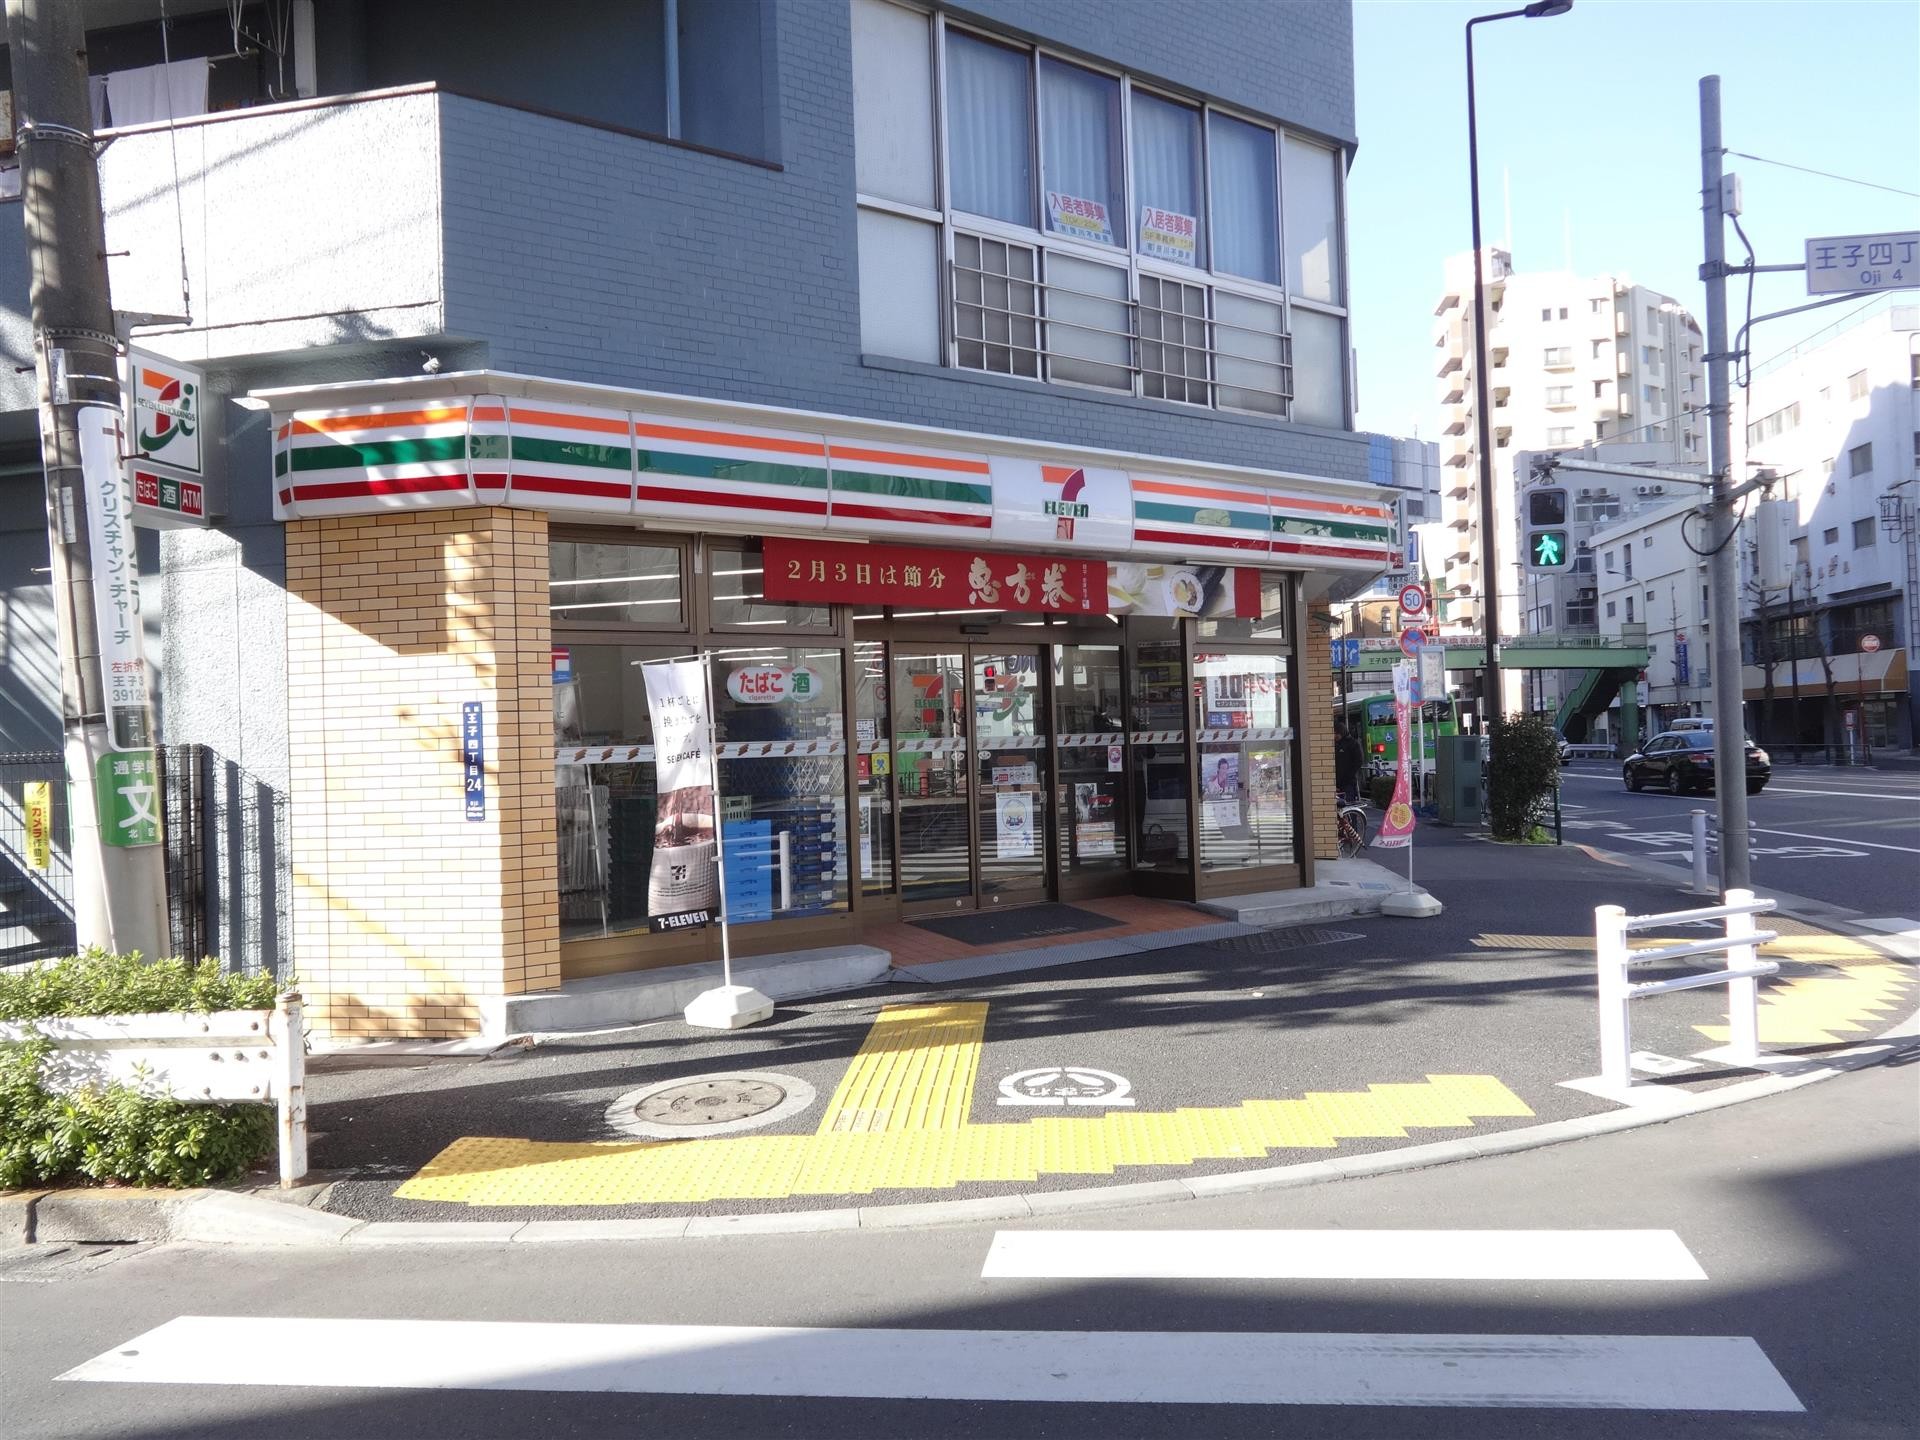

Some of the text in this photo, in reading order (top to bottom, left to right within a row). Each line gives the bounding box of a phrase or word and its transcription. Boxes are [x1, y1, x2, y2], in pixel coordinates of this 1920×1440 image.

[1051, 193, 1105, 221] 入居者募集
[1144, 208, 1193, 237] 入居者募集
[1816, 241, 1919, 269] 王子四丁
[1861, 269, 1903, 285] Oji 4
[137, 480, 200, 508] たばこ 酒 ATM
[788, 560, 946, 589] 2月3日は節分
[1404, 593, 1420, 607] 50
[740, 672, 810, 694] たばこ 酒
[467, 713, 478, 776] 王子四丁目
[467, 778, 481, 792] 24
[117, 779, 158, 828] 文
